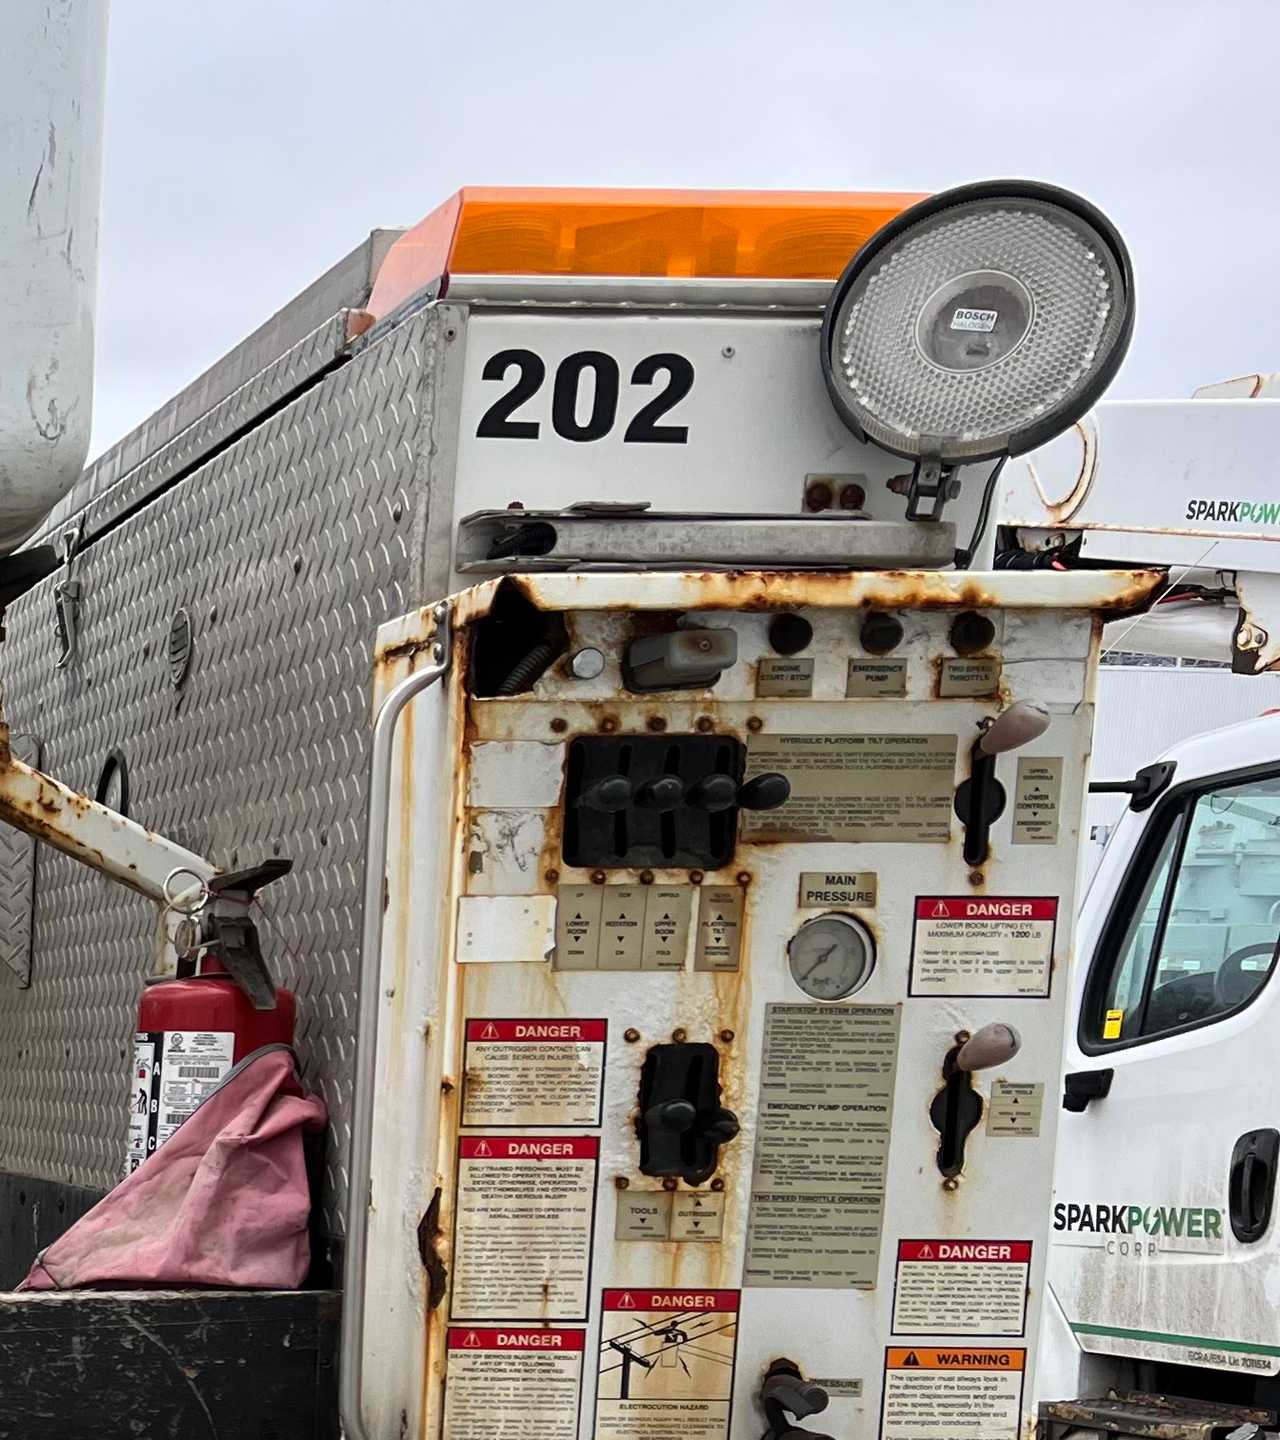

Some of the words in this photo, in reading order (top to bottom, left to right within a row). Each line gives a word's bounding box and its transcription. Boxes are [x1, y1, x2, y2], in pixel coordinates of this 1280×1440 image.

[956, 311, 995, 321] BOSCH
[476, 348, 695, 444] 202
[1185, 500, 1280, 525] SPARKPOW
[852, 665, 903, 673] EMERGENCY
[865, 674, 889, 682] PUMP
[825, 876, 856, 885] MAIN
[807, 891, 872, 902] PRESSURE
[966, 904, 1033, 916] DANGER
[515, 1026, 581, 1038] DANGER
[153, 1062, 160, 1076] A
[150, 1100, 158, 1112] B
[148, 1136, 155, 1150] C
[508, 1143, 574, 1155] DANGER
[1053, 1203, 1223, 1239] SPARKPOWER
[939, 1245, 1011, 1259] DANGER
[651, 1295, 716, 1307] DANGER
[497, 1334, 562, 1346] DANGER
[937, 1354, 1010, 1366] WARNING
[906, 1375, 935, 1383] operator
[887, 1410, 916, 1418] platform
